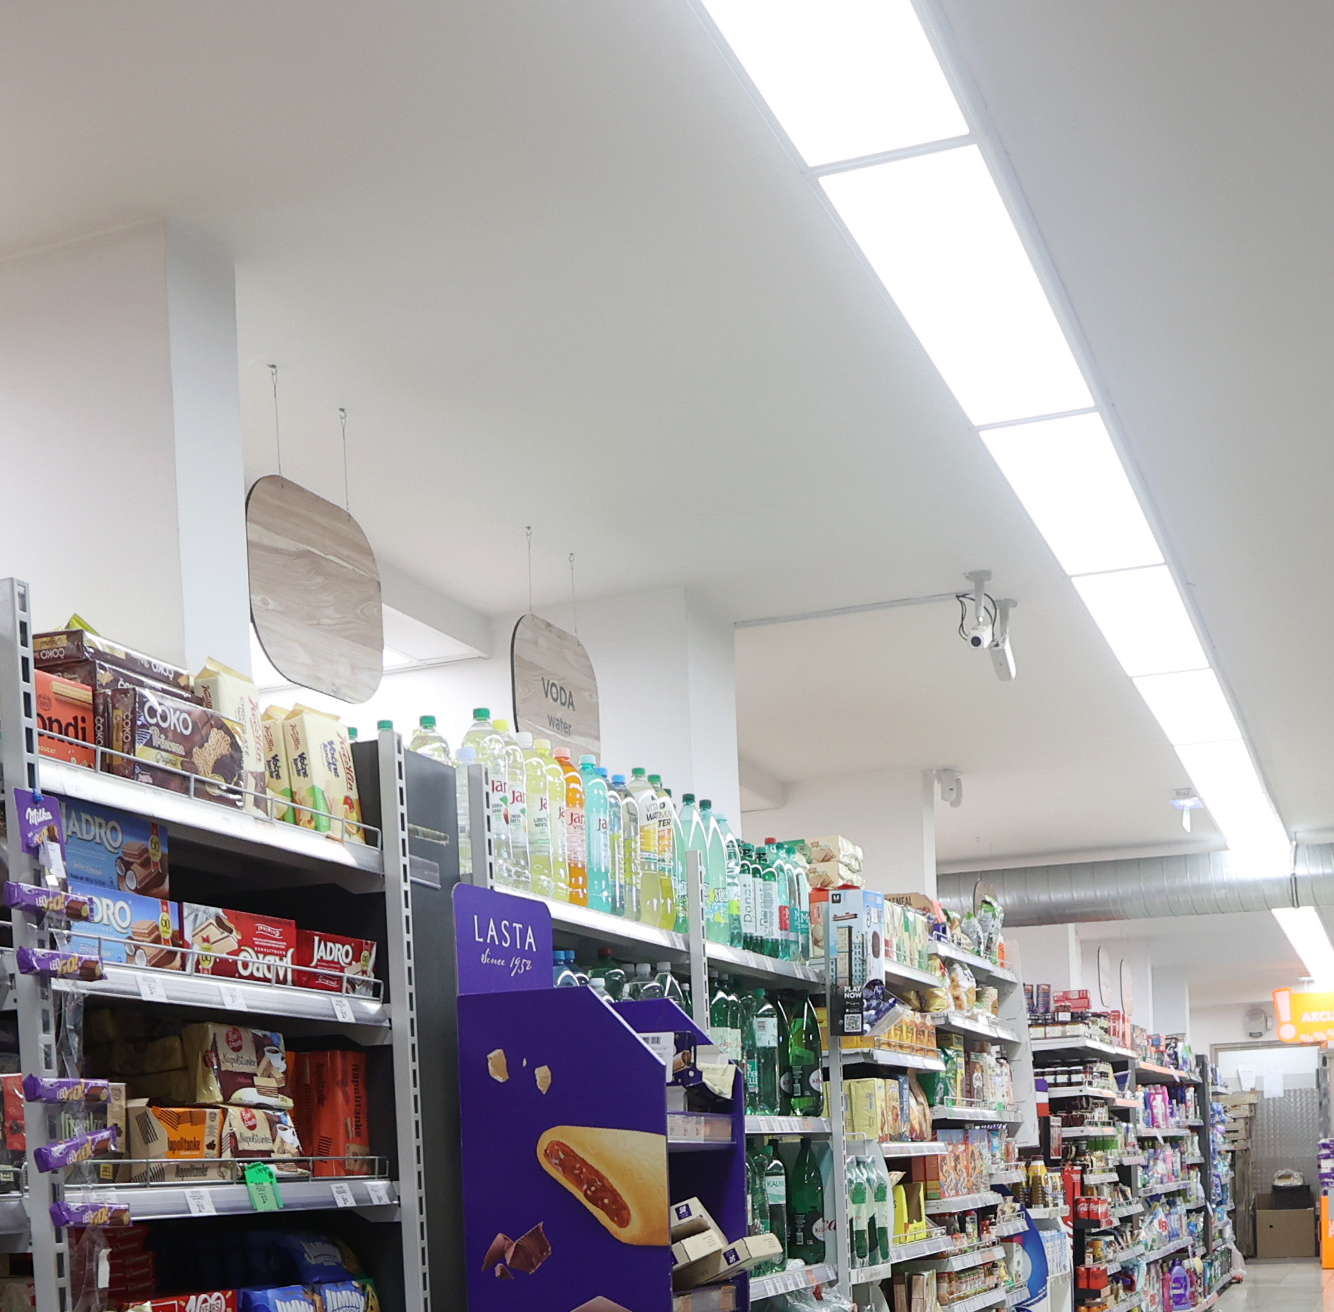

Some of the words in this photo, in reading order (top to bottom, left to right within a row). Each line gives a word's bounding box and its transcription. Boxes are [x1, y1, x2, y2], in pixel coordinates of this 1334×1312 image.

[541, 676, 575, 712] VODA
[548, 714, 572, 736] water
[26, 808, 53, 825] Milka
[65, 808, 123, 854] ADRO
[474, 914, 537, 952] LASTA
[237, 946, 294, 986] JADRO
[310, 936, 353, 967] JADRO
[480, 952, 506, 967] Since
[510, 957, 533, 976] 1952
[167, 1137, 201, 1153] apolitanke
